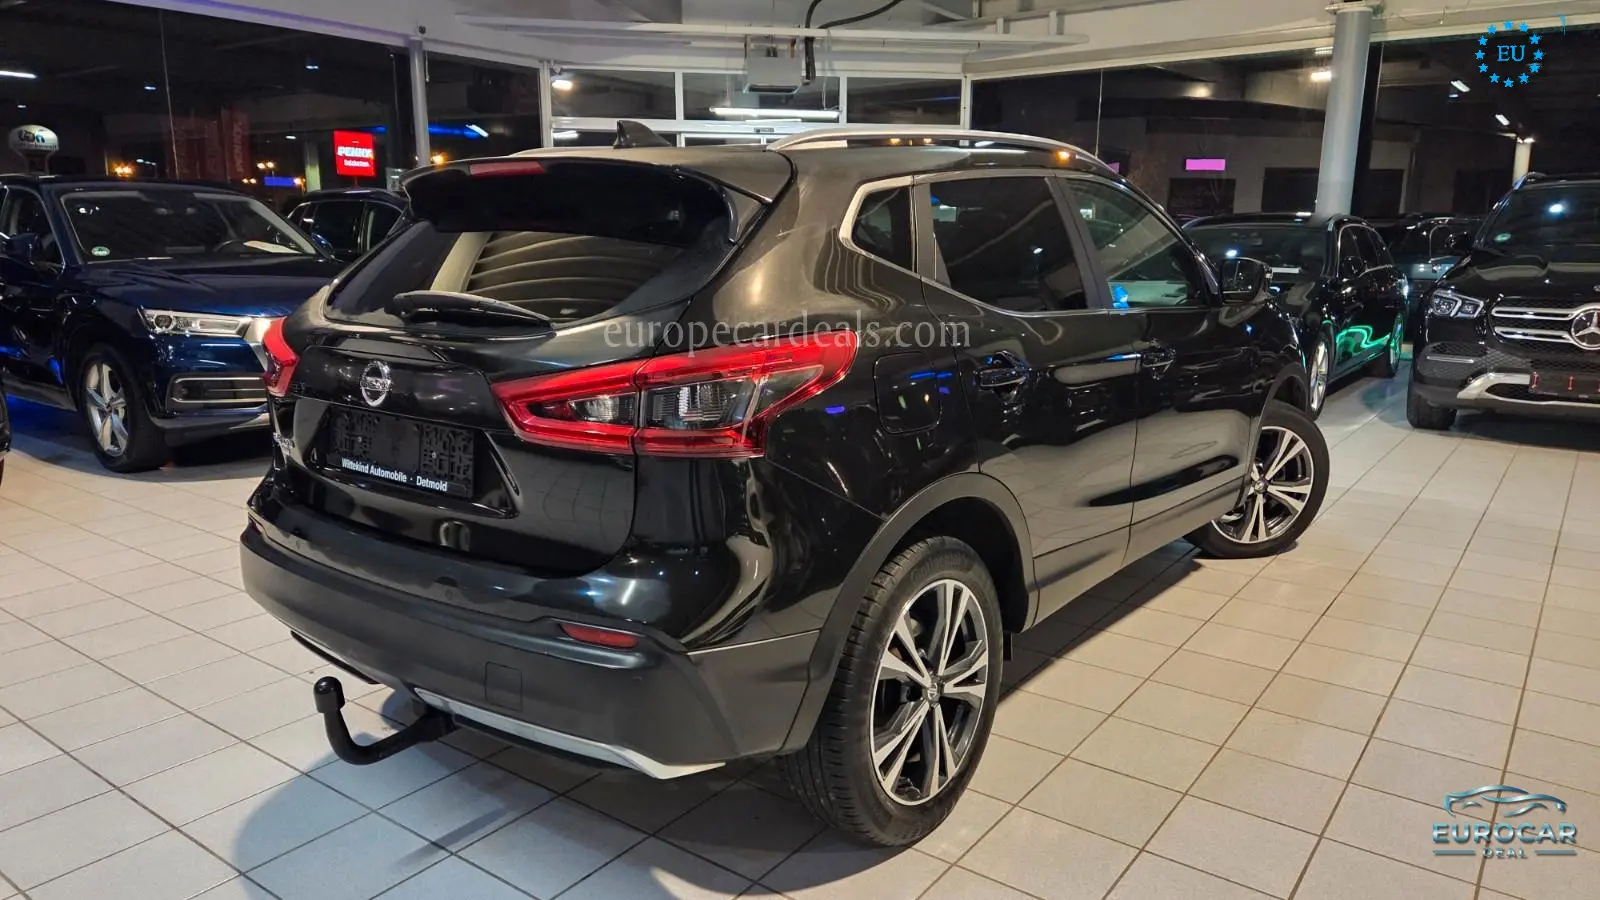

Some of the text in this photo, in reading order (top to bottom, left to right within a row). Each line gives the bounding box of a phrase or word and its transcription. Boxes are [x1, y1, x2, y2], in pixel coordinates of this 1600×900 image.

[341, 457, 448, 492] Wittekind Automobile Detmold
